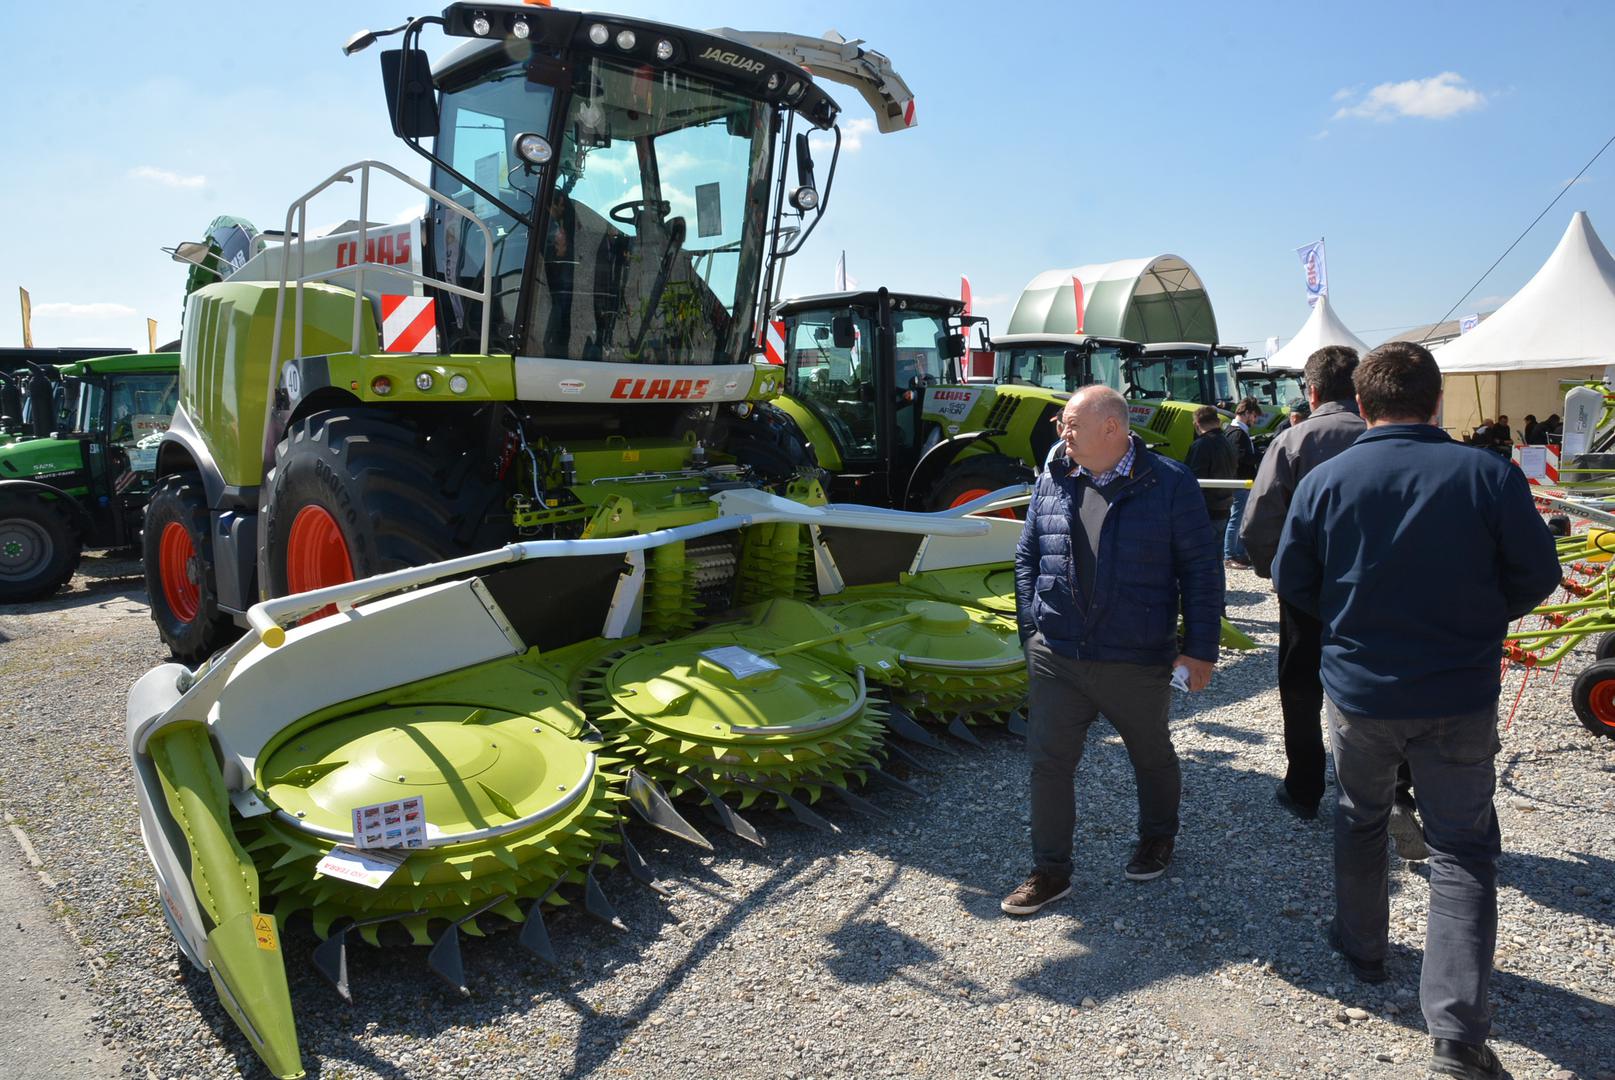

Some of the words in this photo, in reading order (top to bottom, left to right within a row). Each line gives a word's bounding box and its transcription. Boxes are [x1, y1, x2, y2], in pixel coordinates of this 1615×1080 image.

[699, 47, 765, 75] JAGUAR
[336, 232, 411, 268] CLAAS
[289, 370, 298, 392] 40
[610, 378, 711, 400] CLAAS
[934, 391, 971, 401] CLAAS
[1558, 504, 1590, 518] VOLTO
